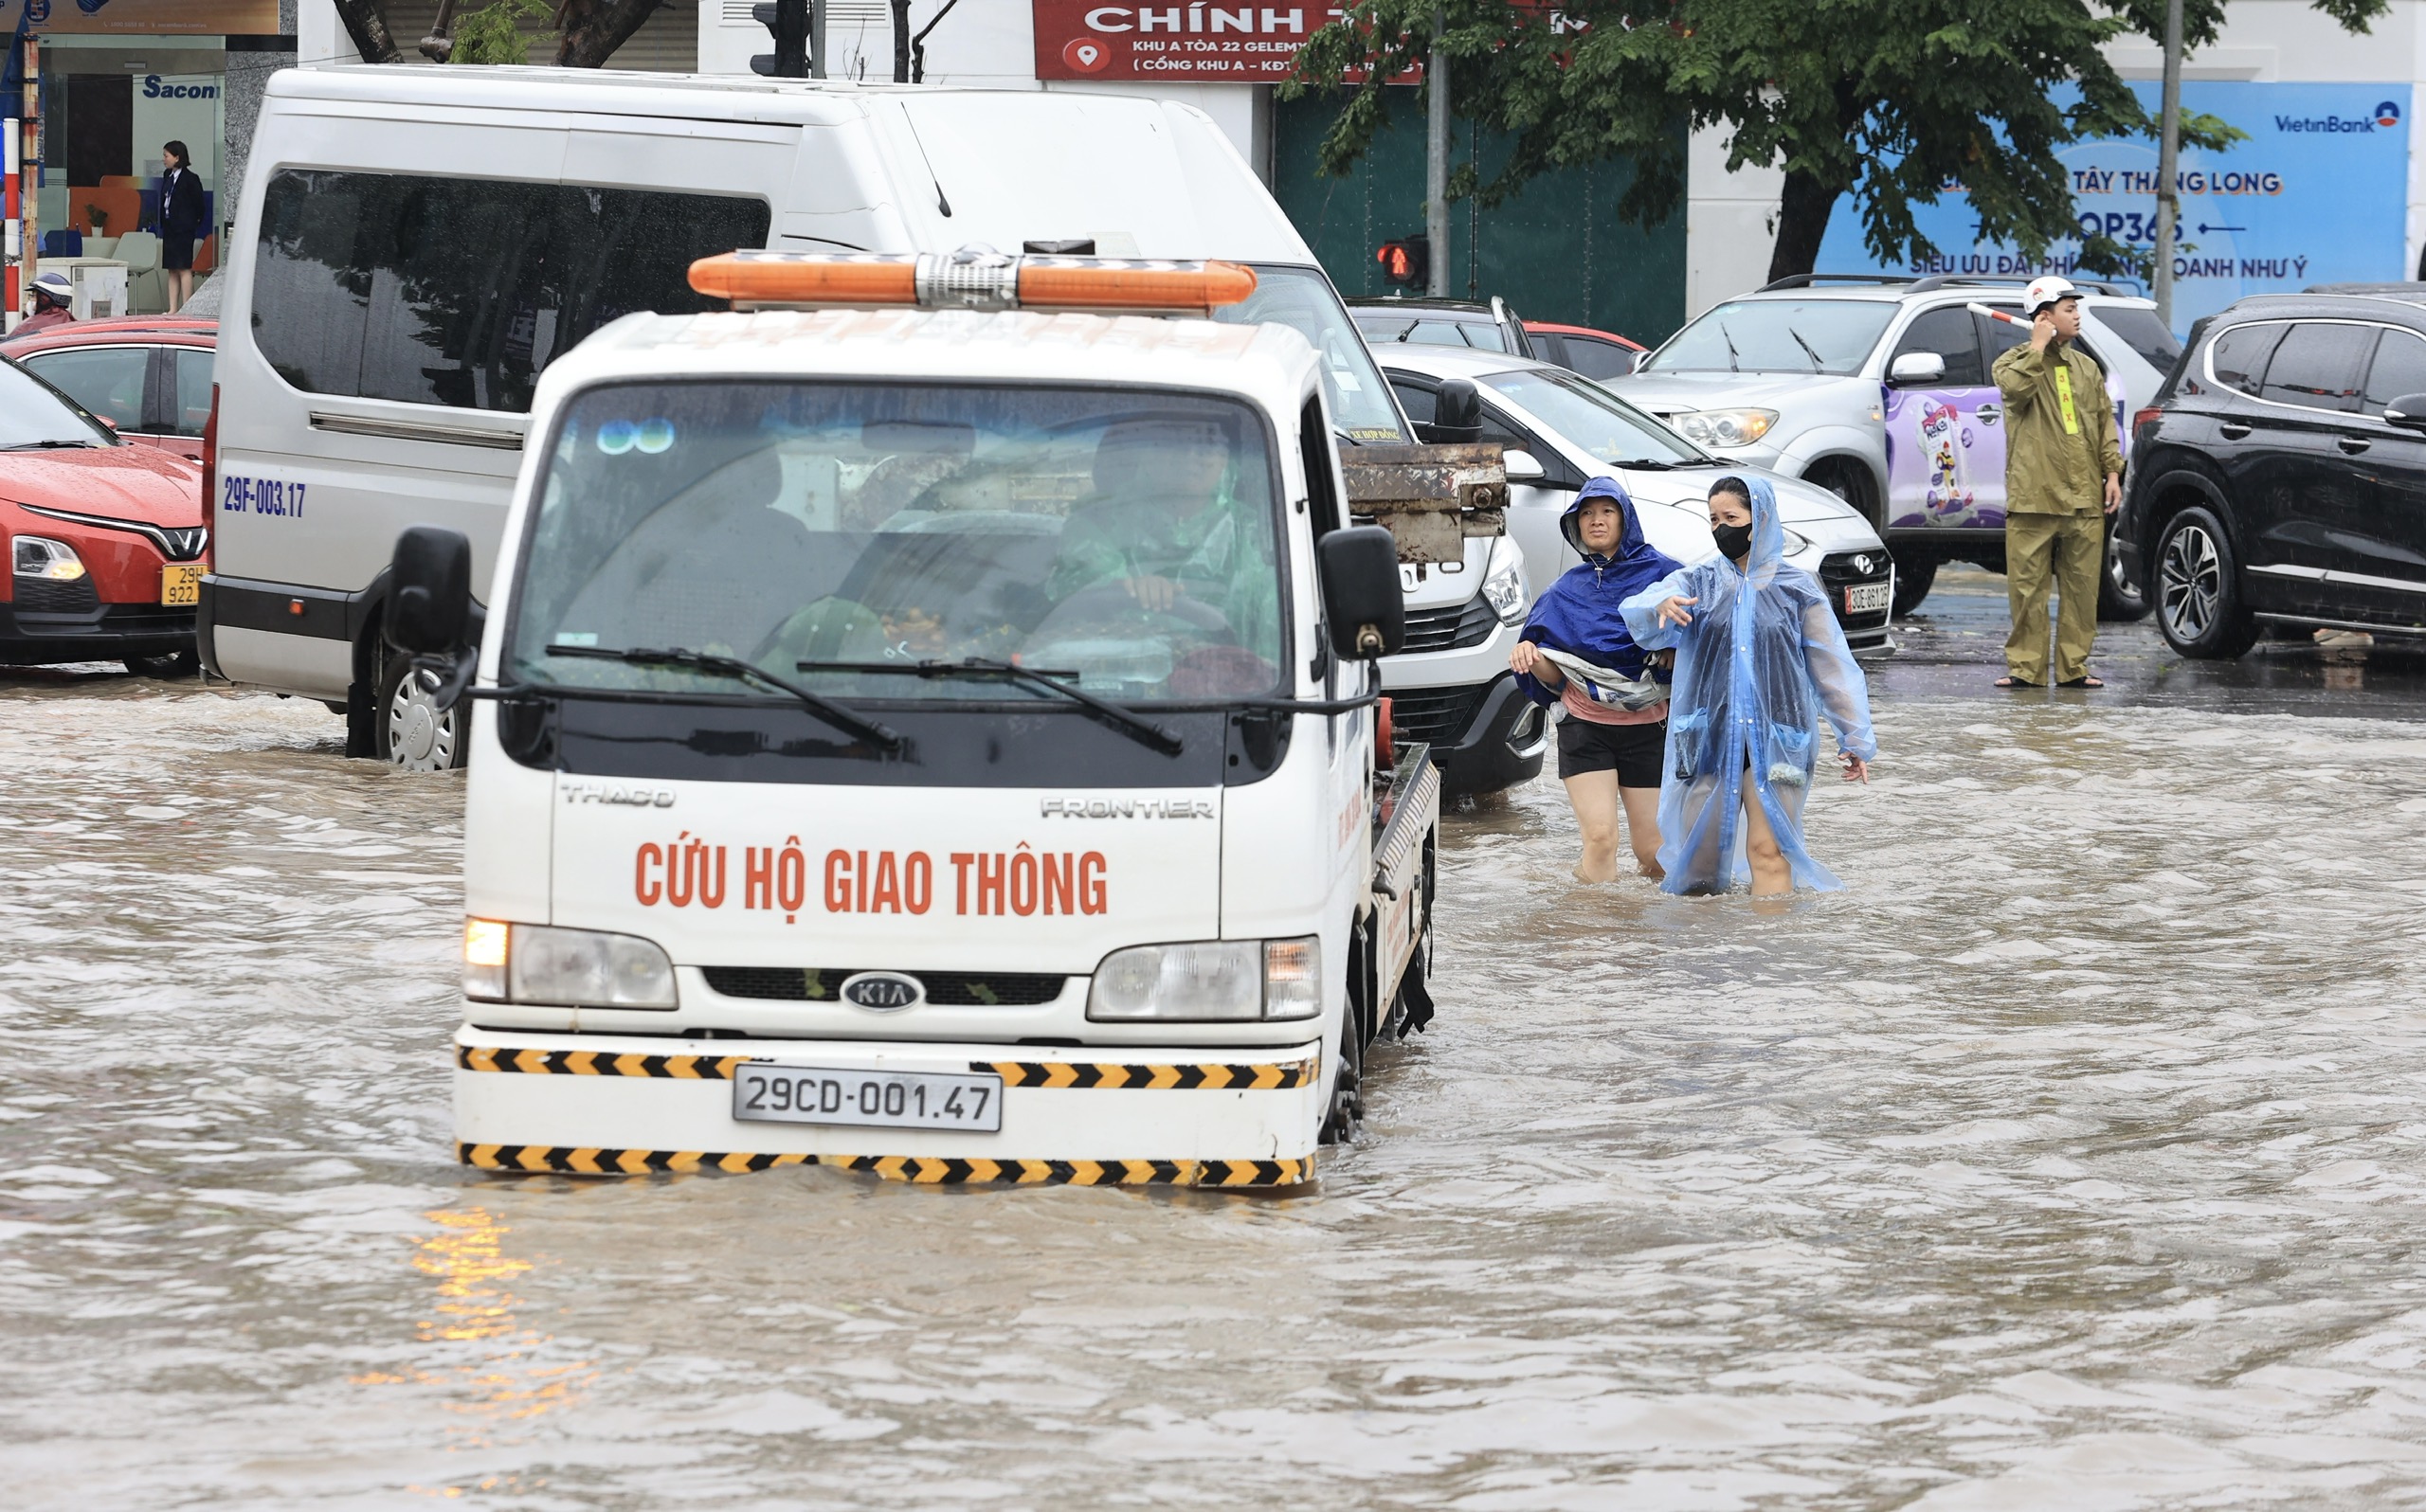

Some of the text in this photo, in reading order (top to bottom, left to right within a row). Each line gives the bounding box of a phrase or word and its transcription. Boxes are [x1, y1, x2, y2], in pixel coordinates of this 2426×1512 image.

[1084, 2, 1303, 34] CHÍNH
[1133, 41, 1166, 52] KHU
[1168, 41, 1182, 52] A
[1186, 38, 1219, 52] TÒA
[1222, 41, 1240, 52] 22
[1142, 56, 1193, 71] CỔNG
[1196, 59, 1230, 71] KHU
[1232, 60, 1245, 71] A
[2274, 115, 2376, 133] VietinBank
[2073, 165, 2116, 193] TÂY
[2212, 171, 2283, 195] LONG
[2173, 258, 2234, 278] OANH
[2241, 257, 2290, 279] NHƯ
[2293, 254, 2308, 279] Ý
[224, 476, 306, 518] 29F-003.17
[169, 586, 199, 603] 922.
[560, 783, 677, 809] THACO
[1041, 797, 1215, 819] FRONTIER
[635, 831, 1108, 925] CỨU HỘ GIAO THÔNG
[855, 981, 909, 1006] KIA
[745, 1074, 991, 1123] 29CD-001.47
